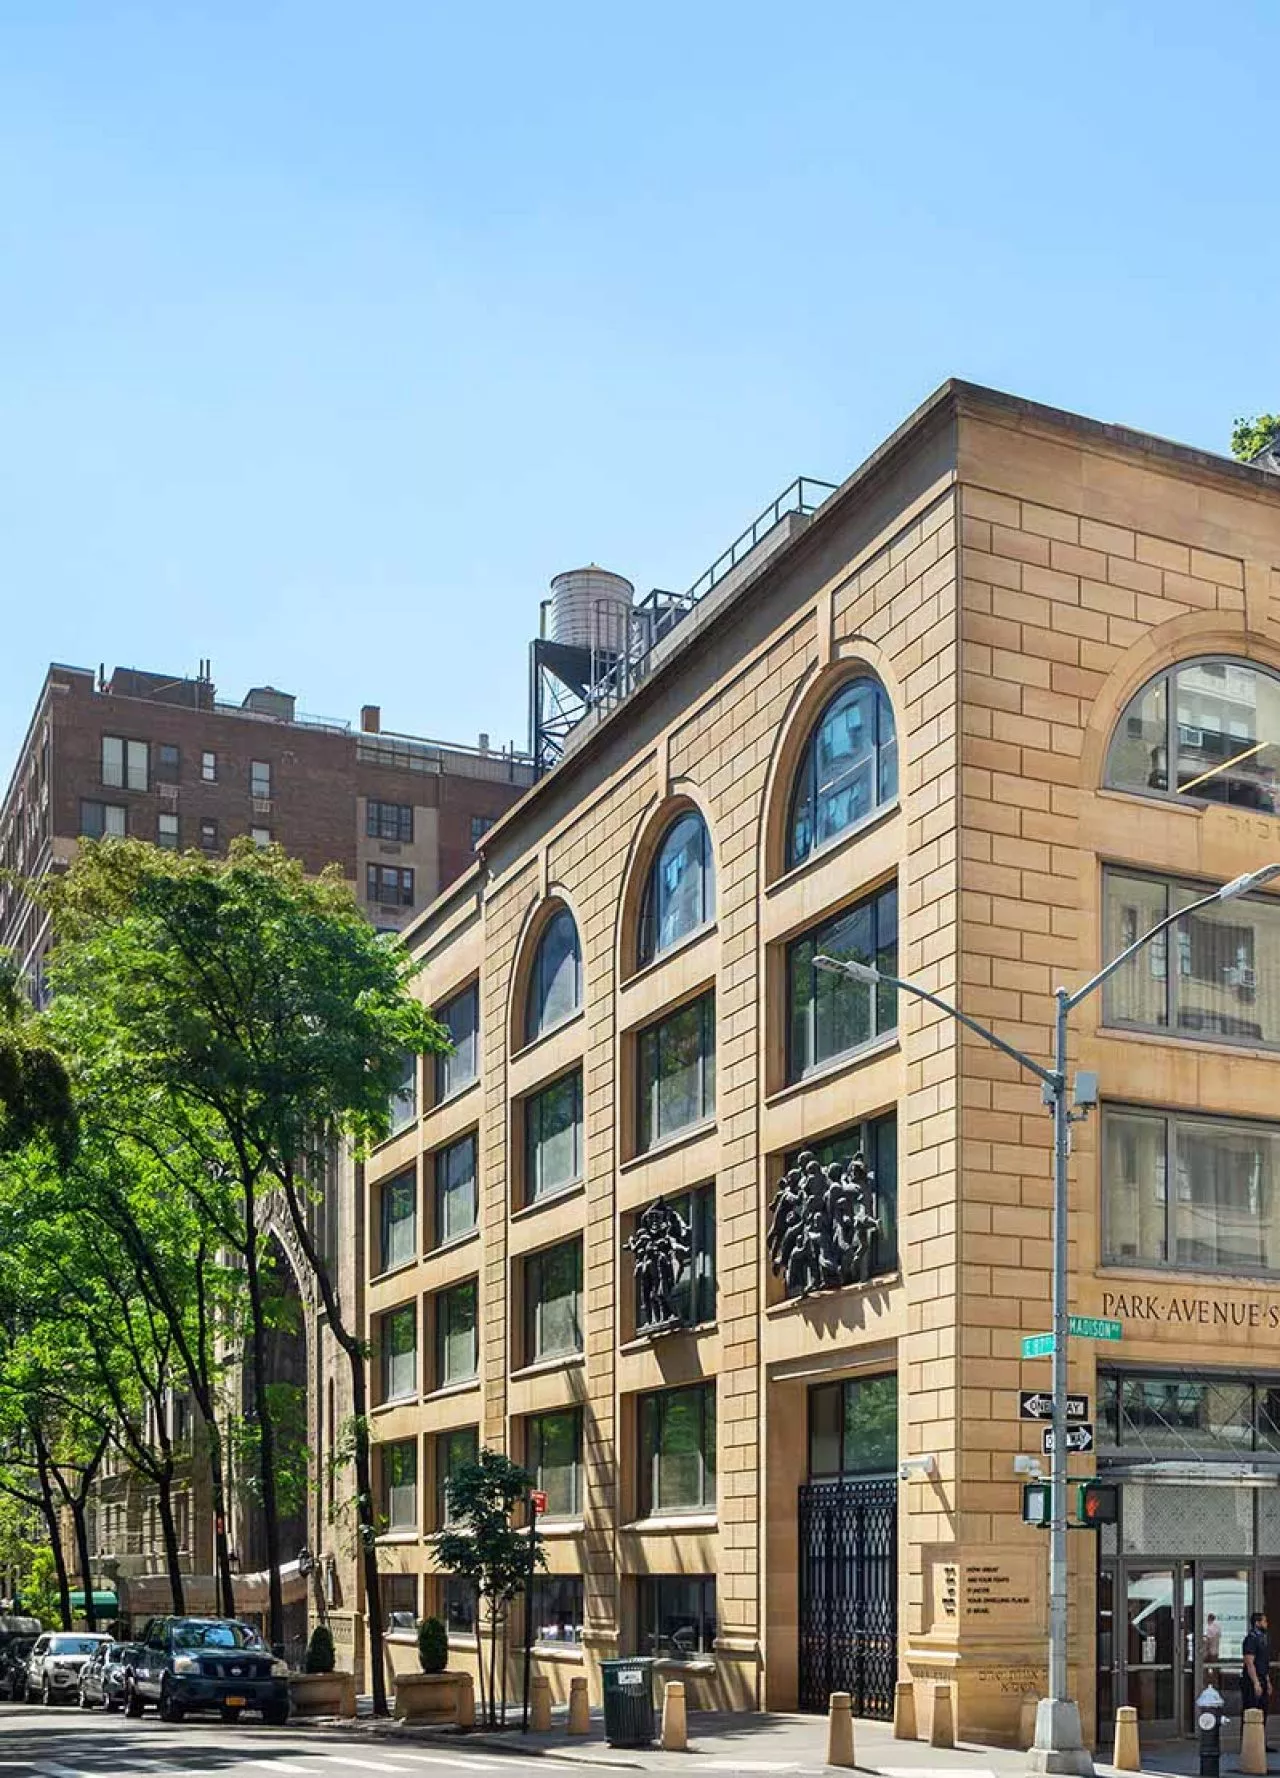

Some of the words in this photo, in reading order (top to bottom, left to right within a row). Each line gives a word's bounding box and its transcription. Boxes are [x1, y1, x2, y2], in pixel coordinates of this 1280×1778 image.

[1102, 1292, 1160, 1320] PARK
[1166, 1297, 1258, 1327] AVENUE
[1069, 1318, 1111, 1338] MADISON
[1029, 1402, 1051, 1412] ONE
[1066, 1402, 1080, 1412] AY
